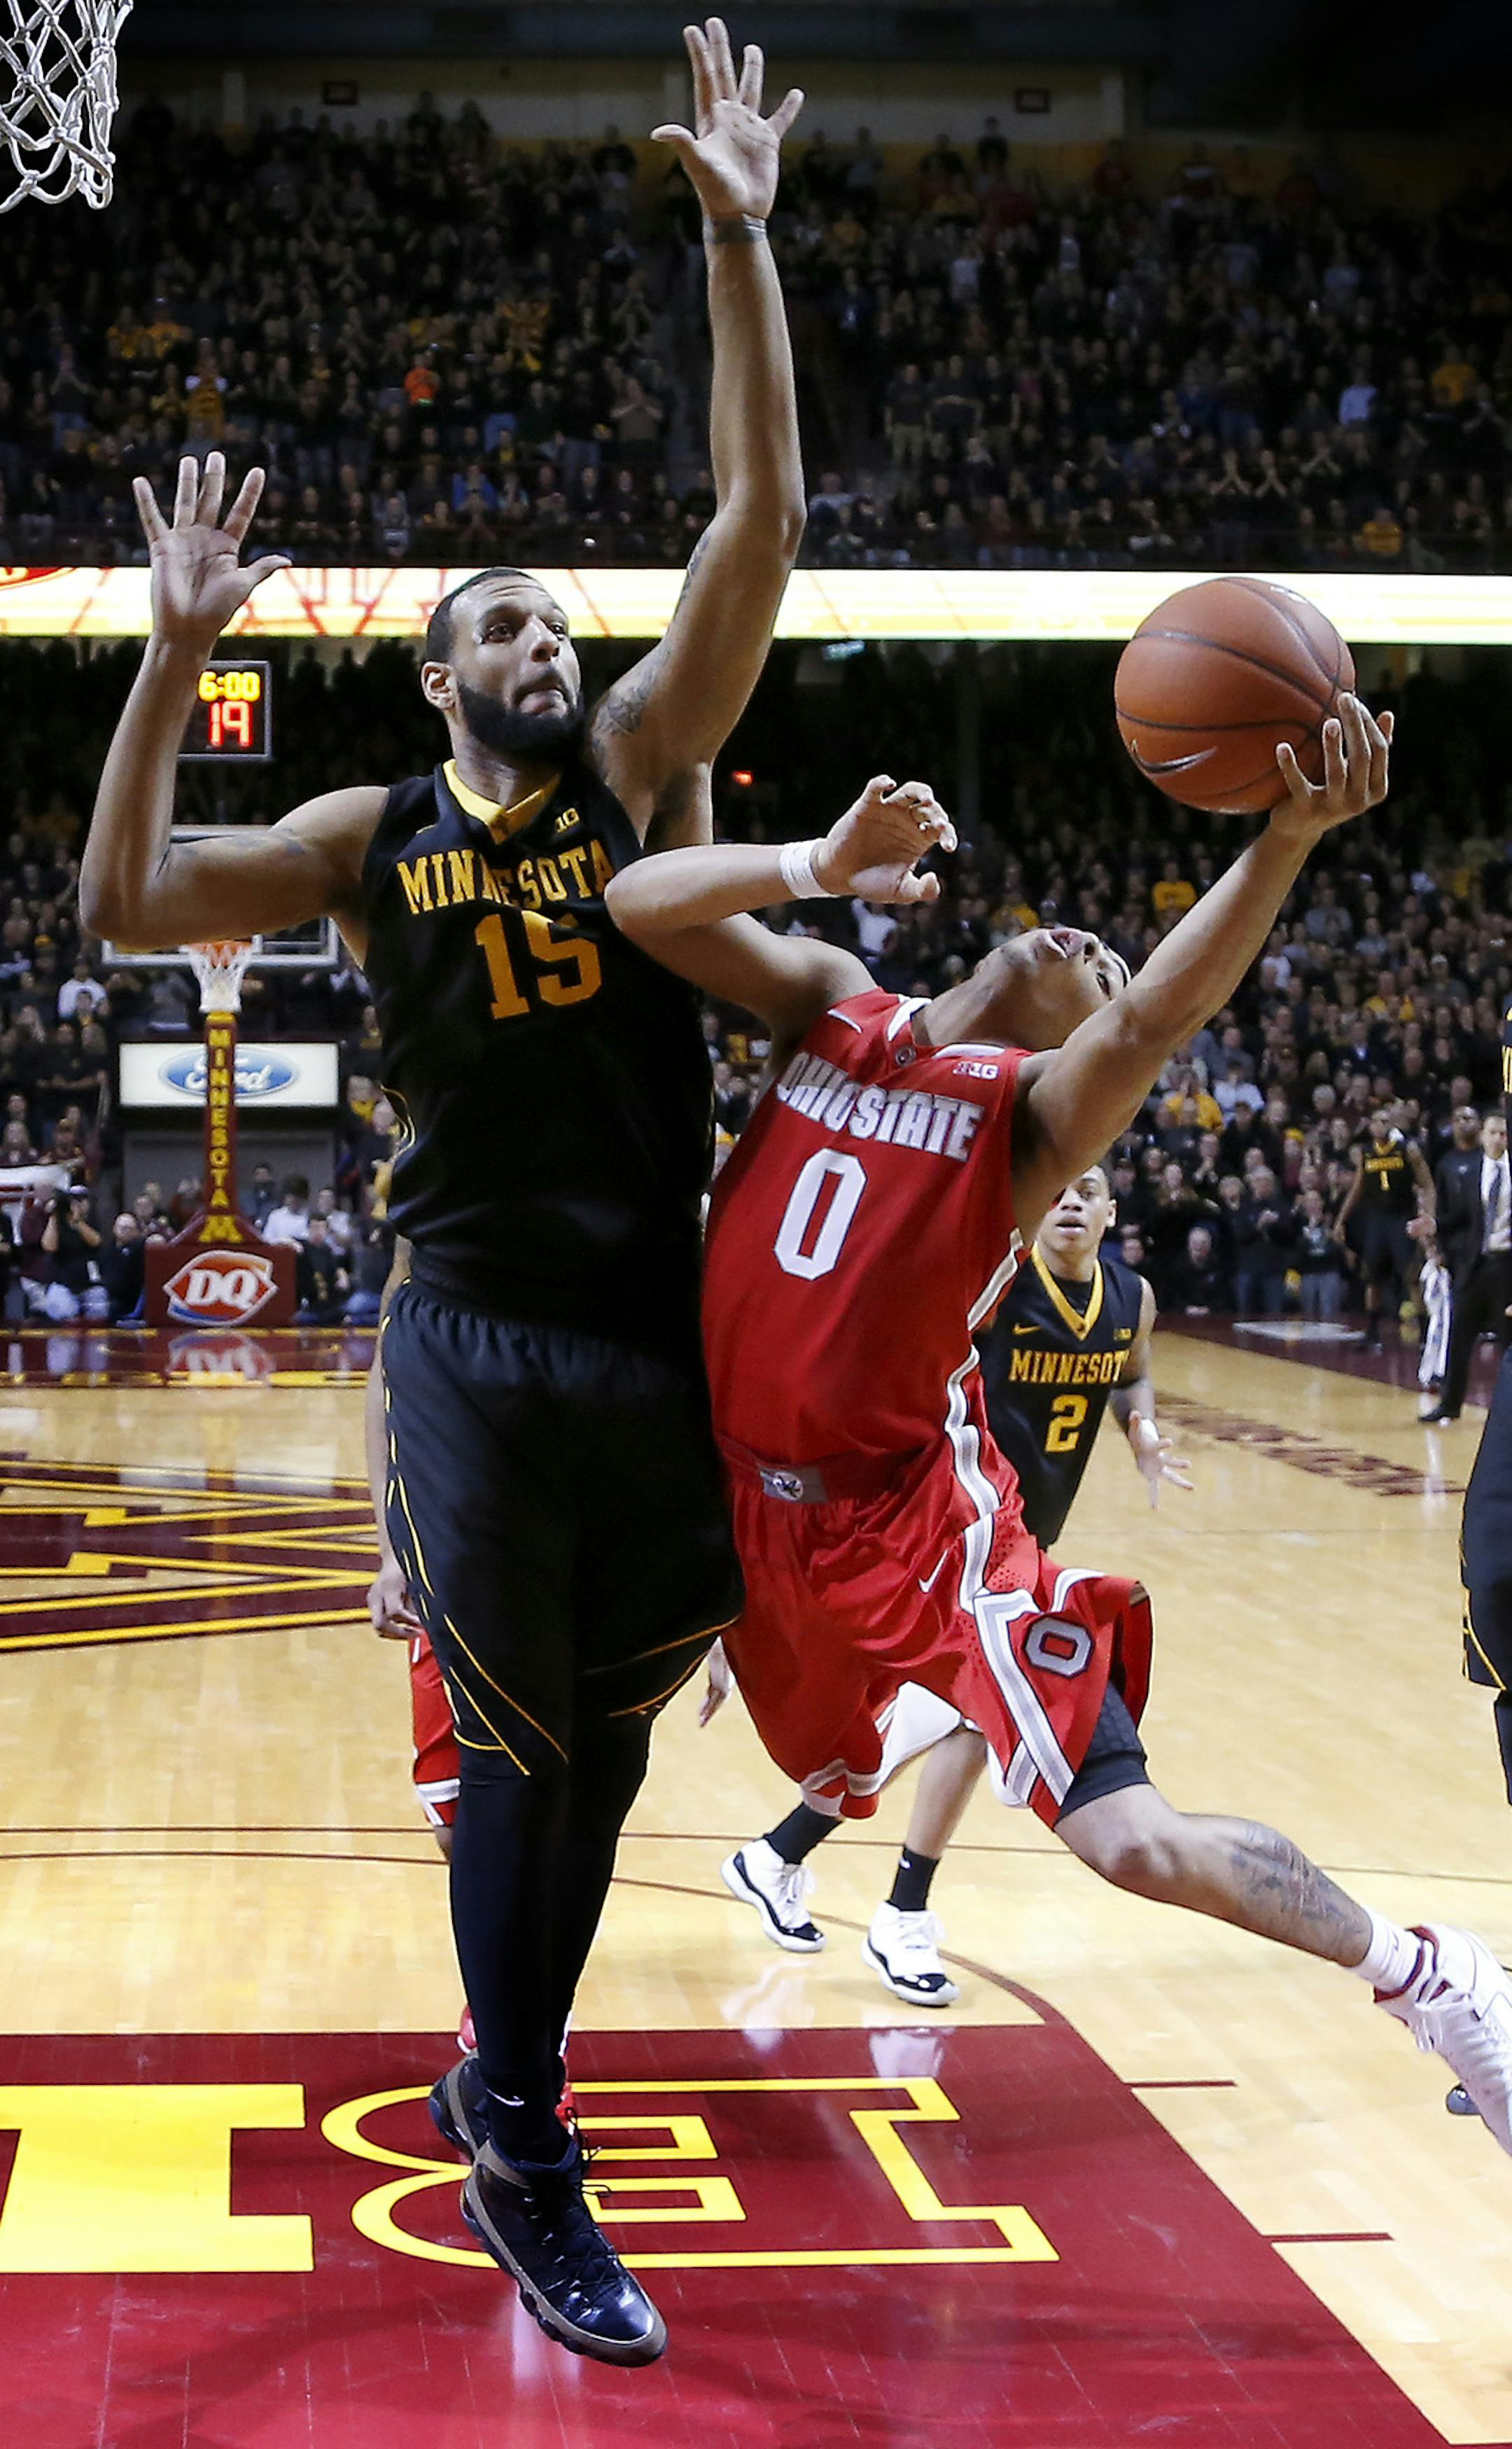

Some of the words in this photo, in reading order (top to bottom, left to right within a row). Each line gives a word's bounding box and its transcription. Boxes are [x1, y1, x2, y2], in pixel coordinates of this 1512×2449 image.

[198, 671, 260, 702] 6:00
[211, 700, 250, 747] 19
[475, 910, 601, 1019] 15
[208, 1028, 231, 1208] MINNESOTA
[848, 1084, 985, 1162] STATE
[774, 1147, 867, 1282] 0
[185, 1268, 261, 1311] DQ
[1009, 1348, 1130, 1384] MINNESOT
[1044, 1393, 1088, 1453] 2
